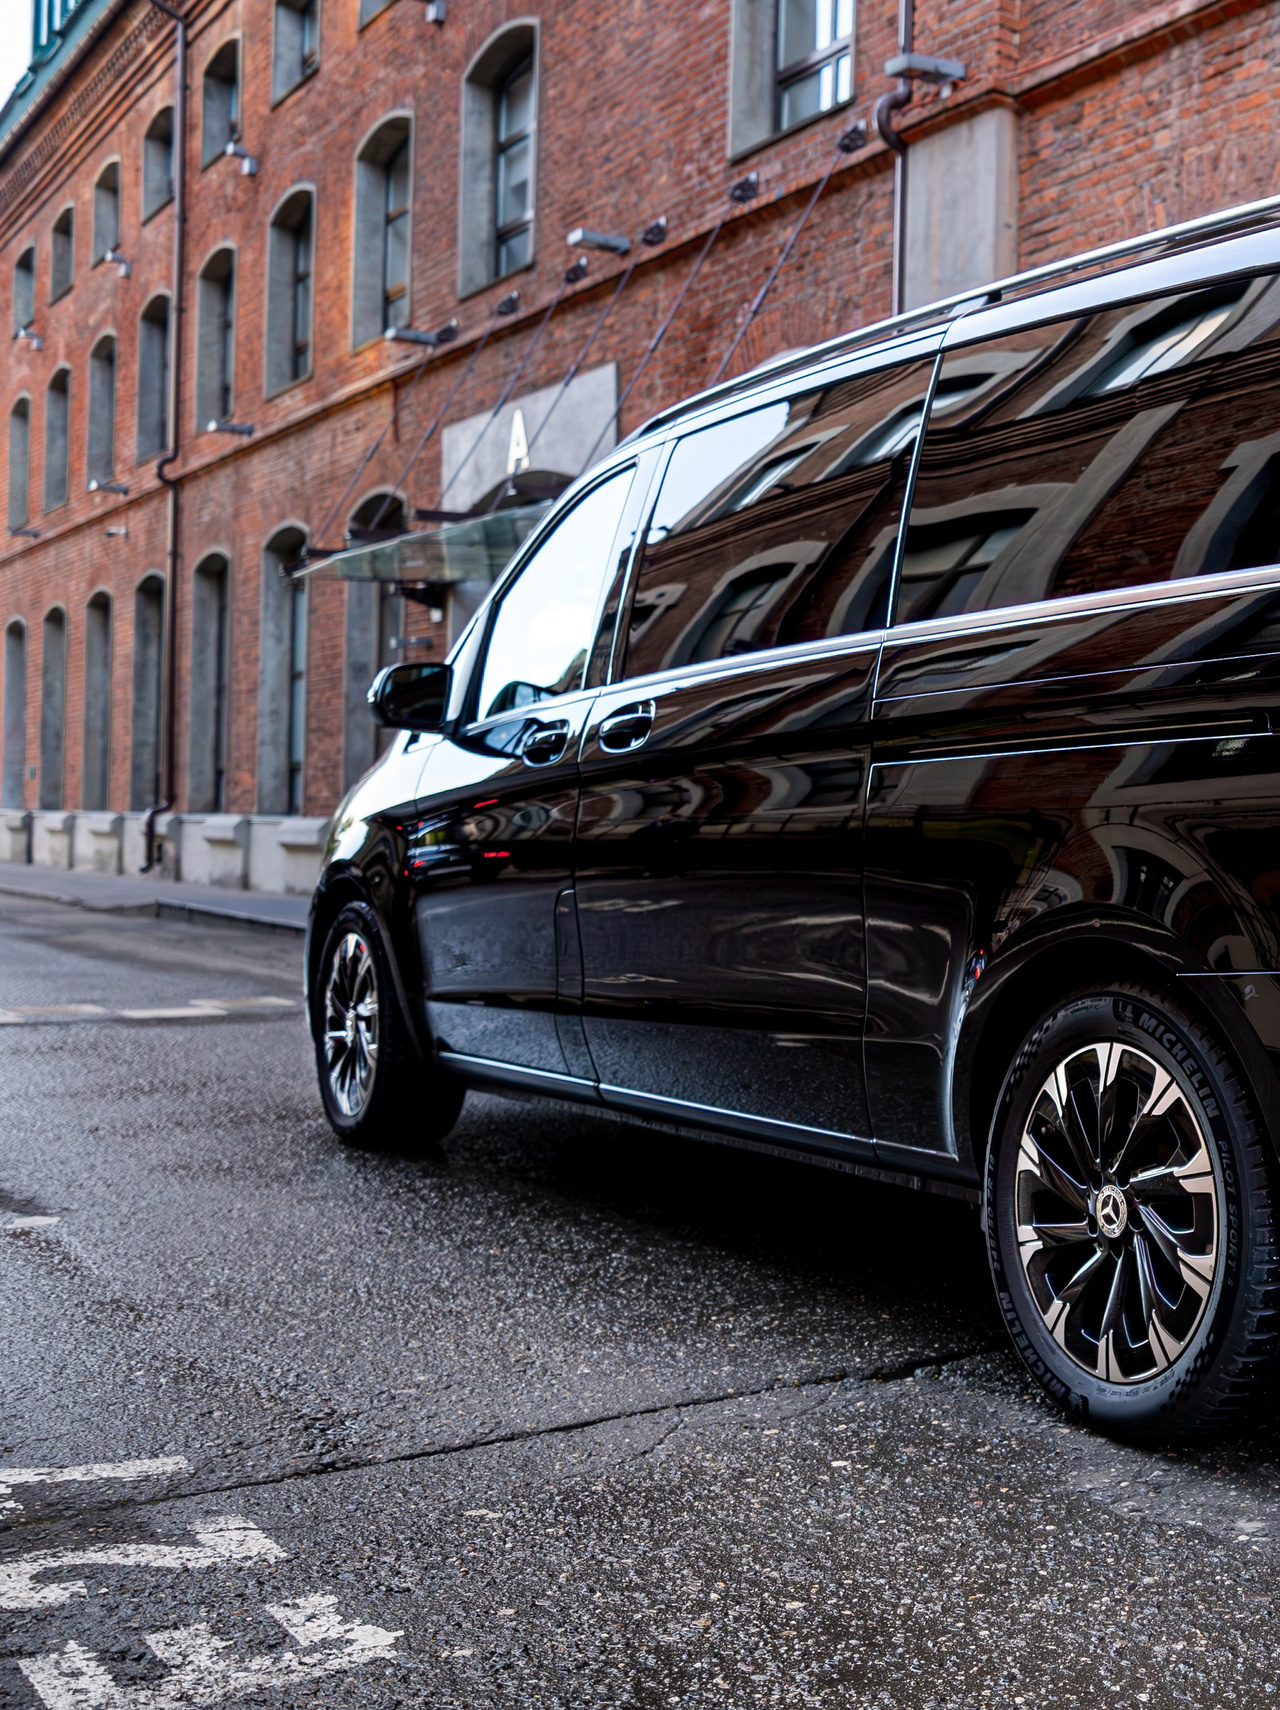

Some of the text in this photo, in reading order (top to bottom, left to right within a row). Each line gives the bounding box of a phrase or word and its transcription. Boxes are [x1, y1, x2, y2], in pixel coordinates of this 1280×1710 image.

[1138, 1012, 1220, 1119] MICHELIN
[1218, 1140, 1237, 1199] PILOT
[1227, 1202, 1239, 1271] SPORT
[999, 1291, 1067, 1400] MICHELIN
